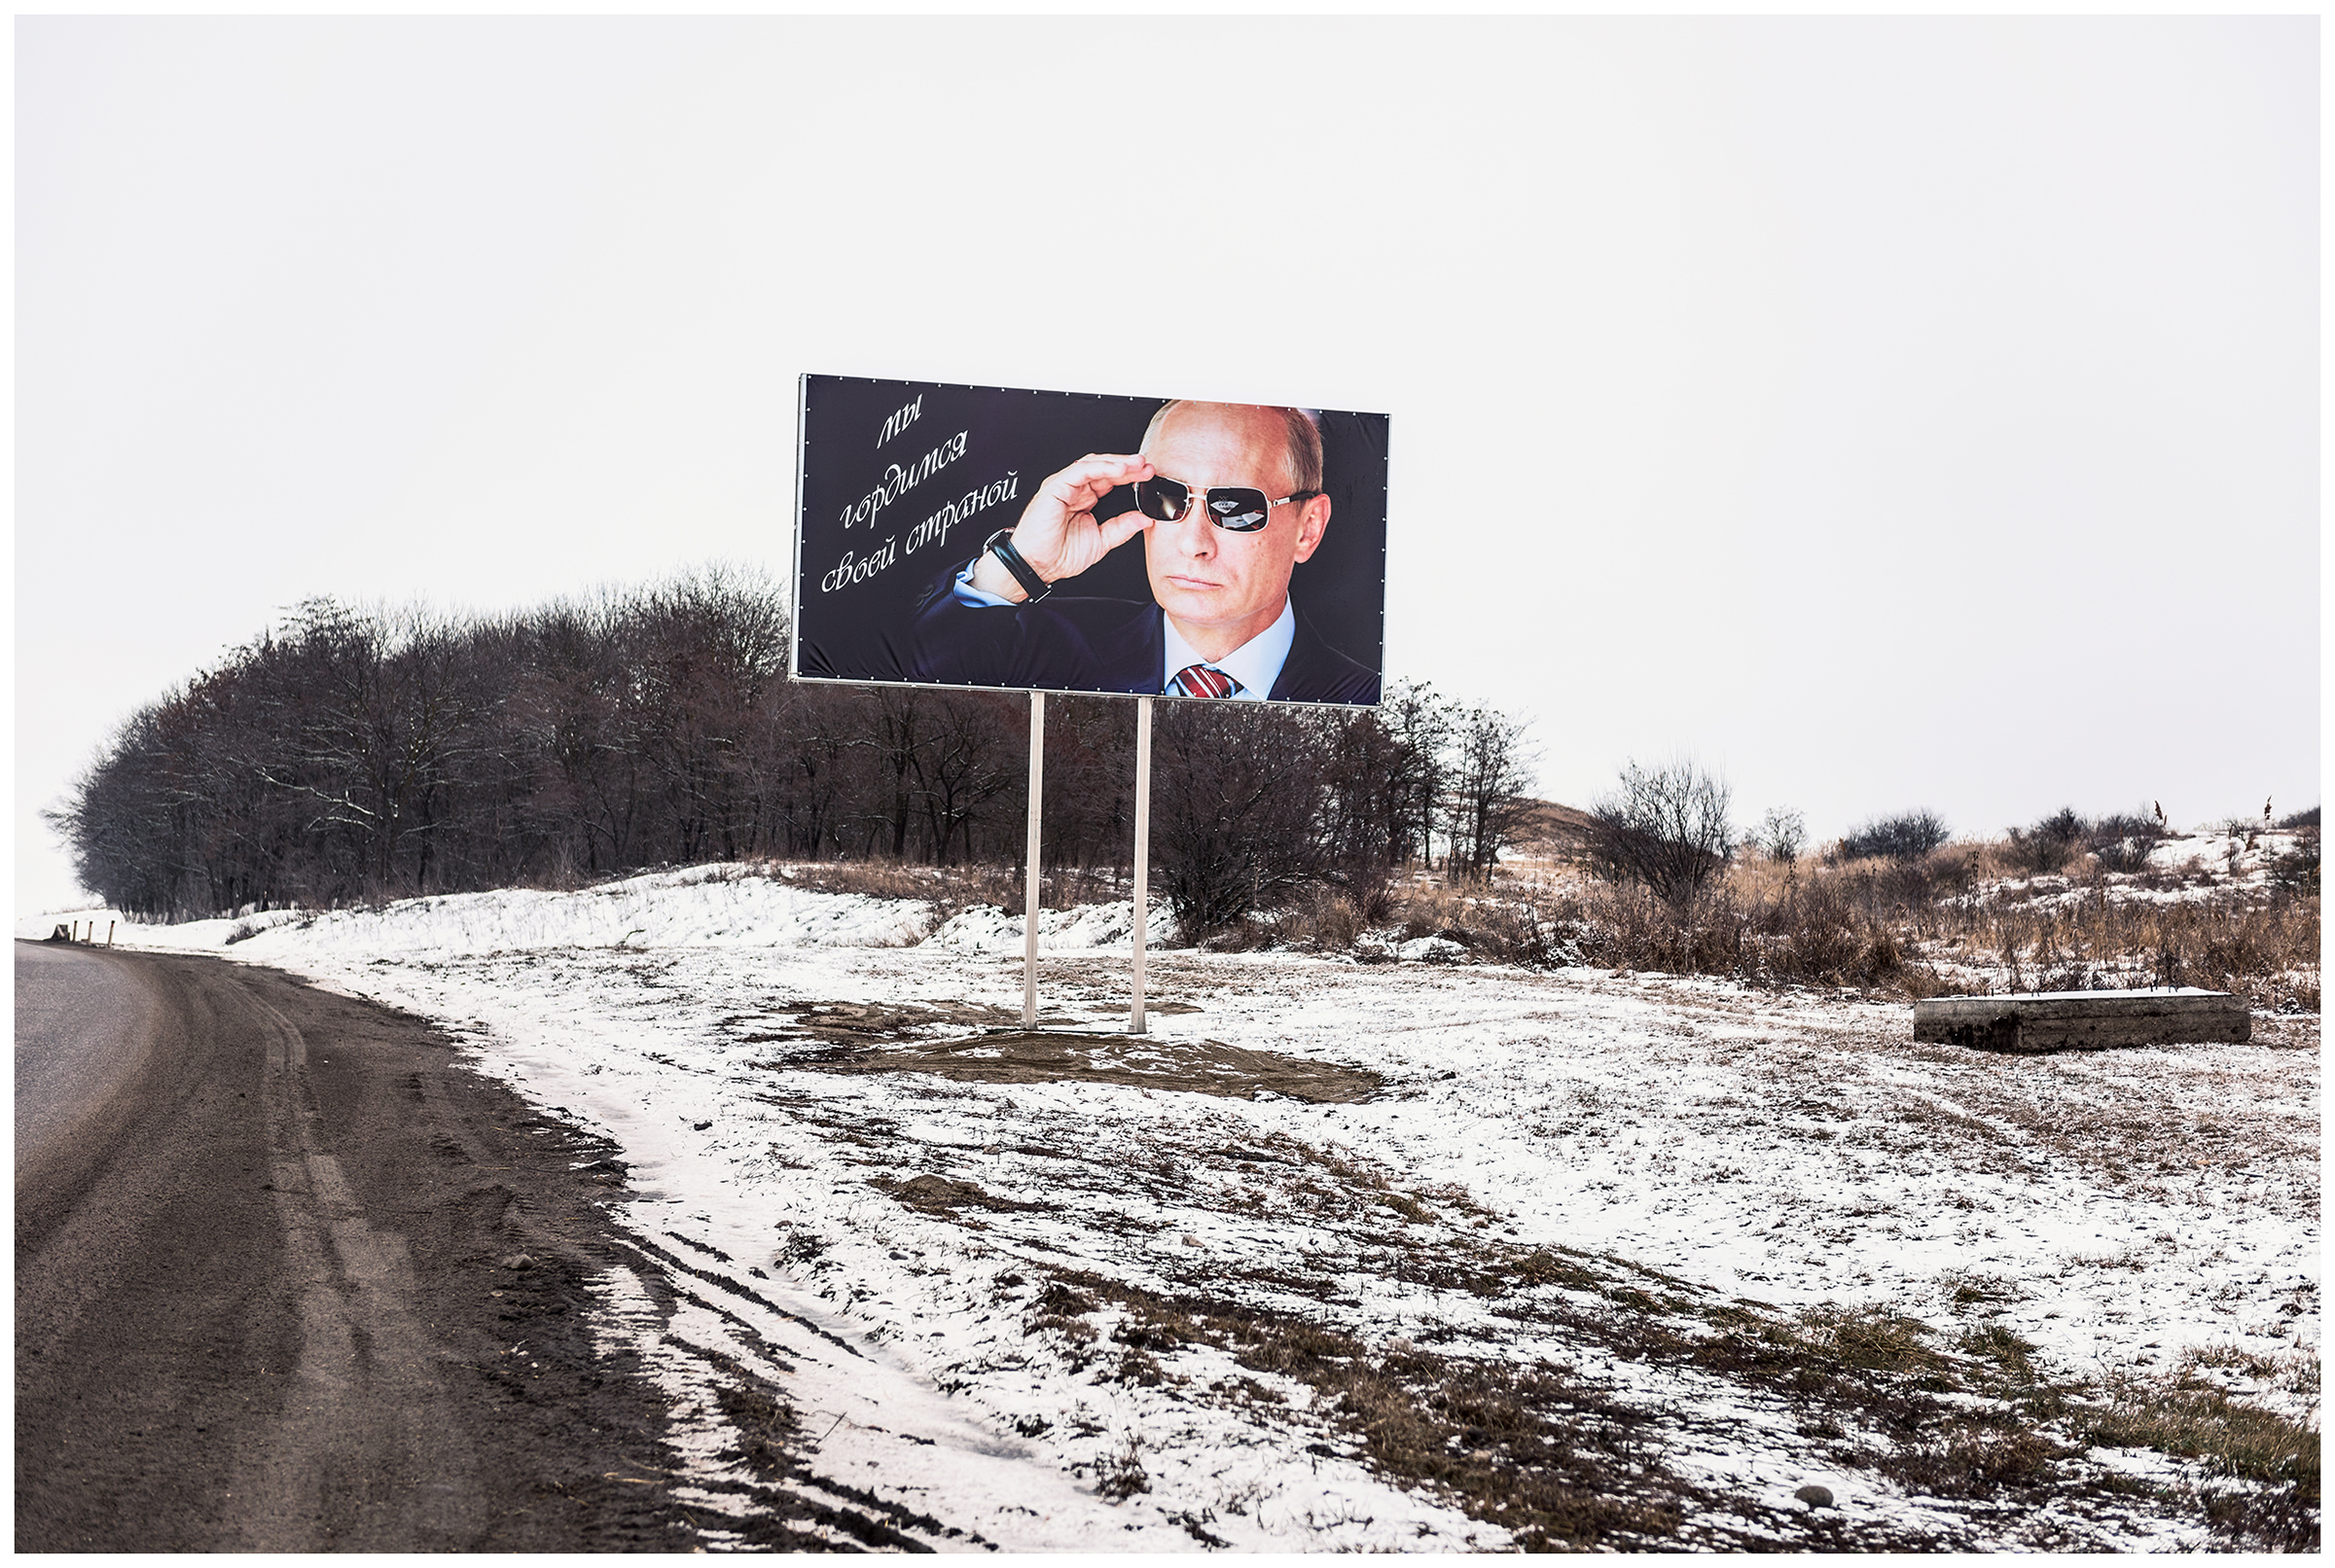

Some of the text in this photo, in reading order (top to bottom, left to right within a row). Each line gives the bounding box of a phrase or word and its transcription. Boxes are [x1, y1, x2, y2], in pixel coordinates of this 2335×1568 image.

[877, 393, 923, 449] мы
[839, 429, 968, 529] гордимся
[821, 470, 1019, 593] своей страной
